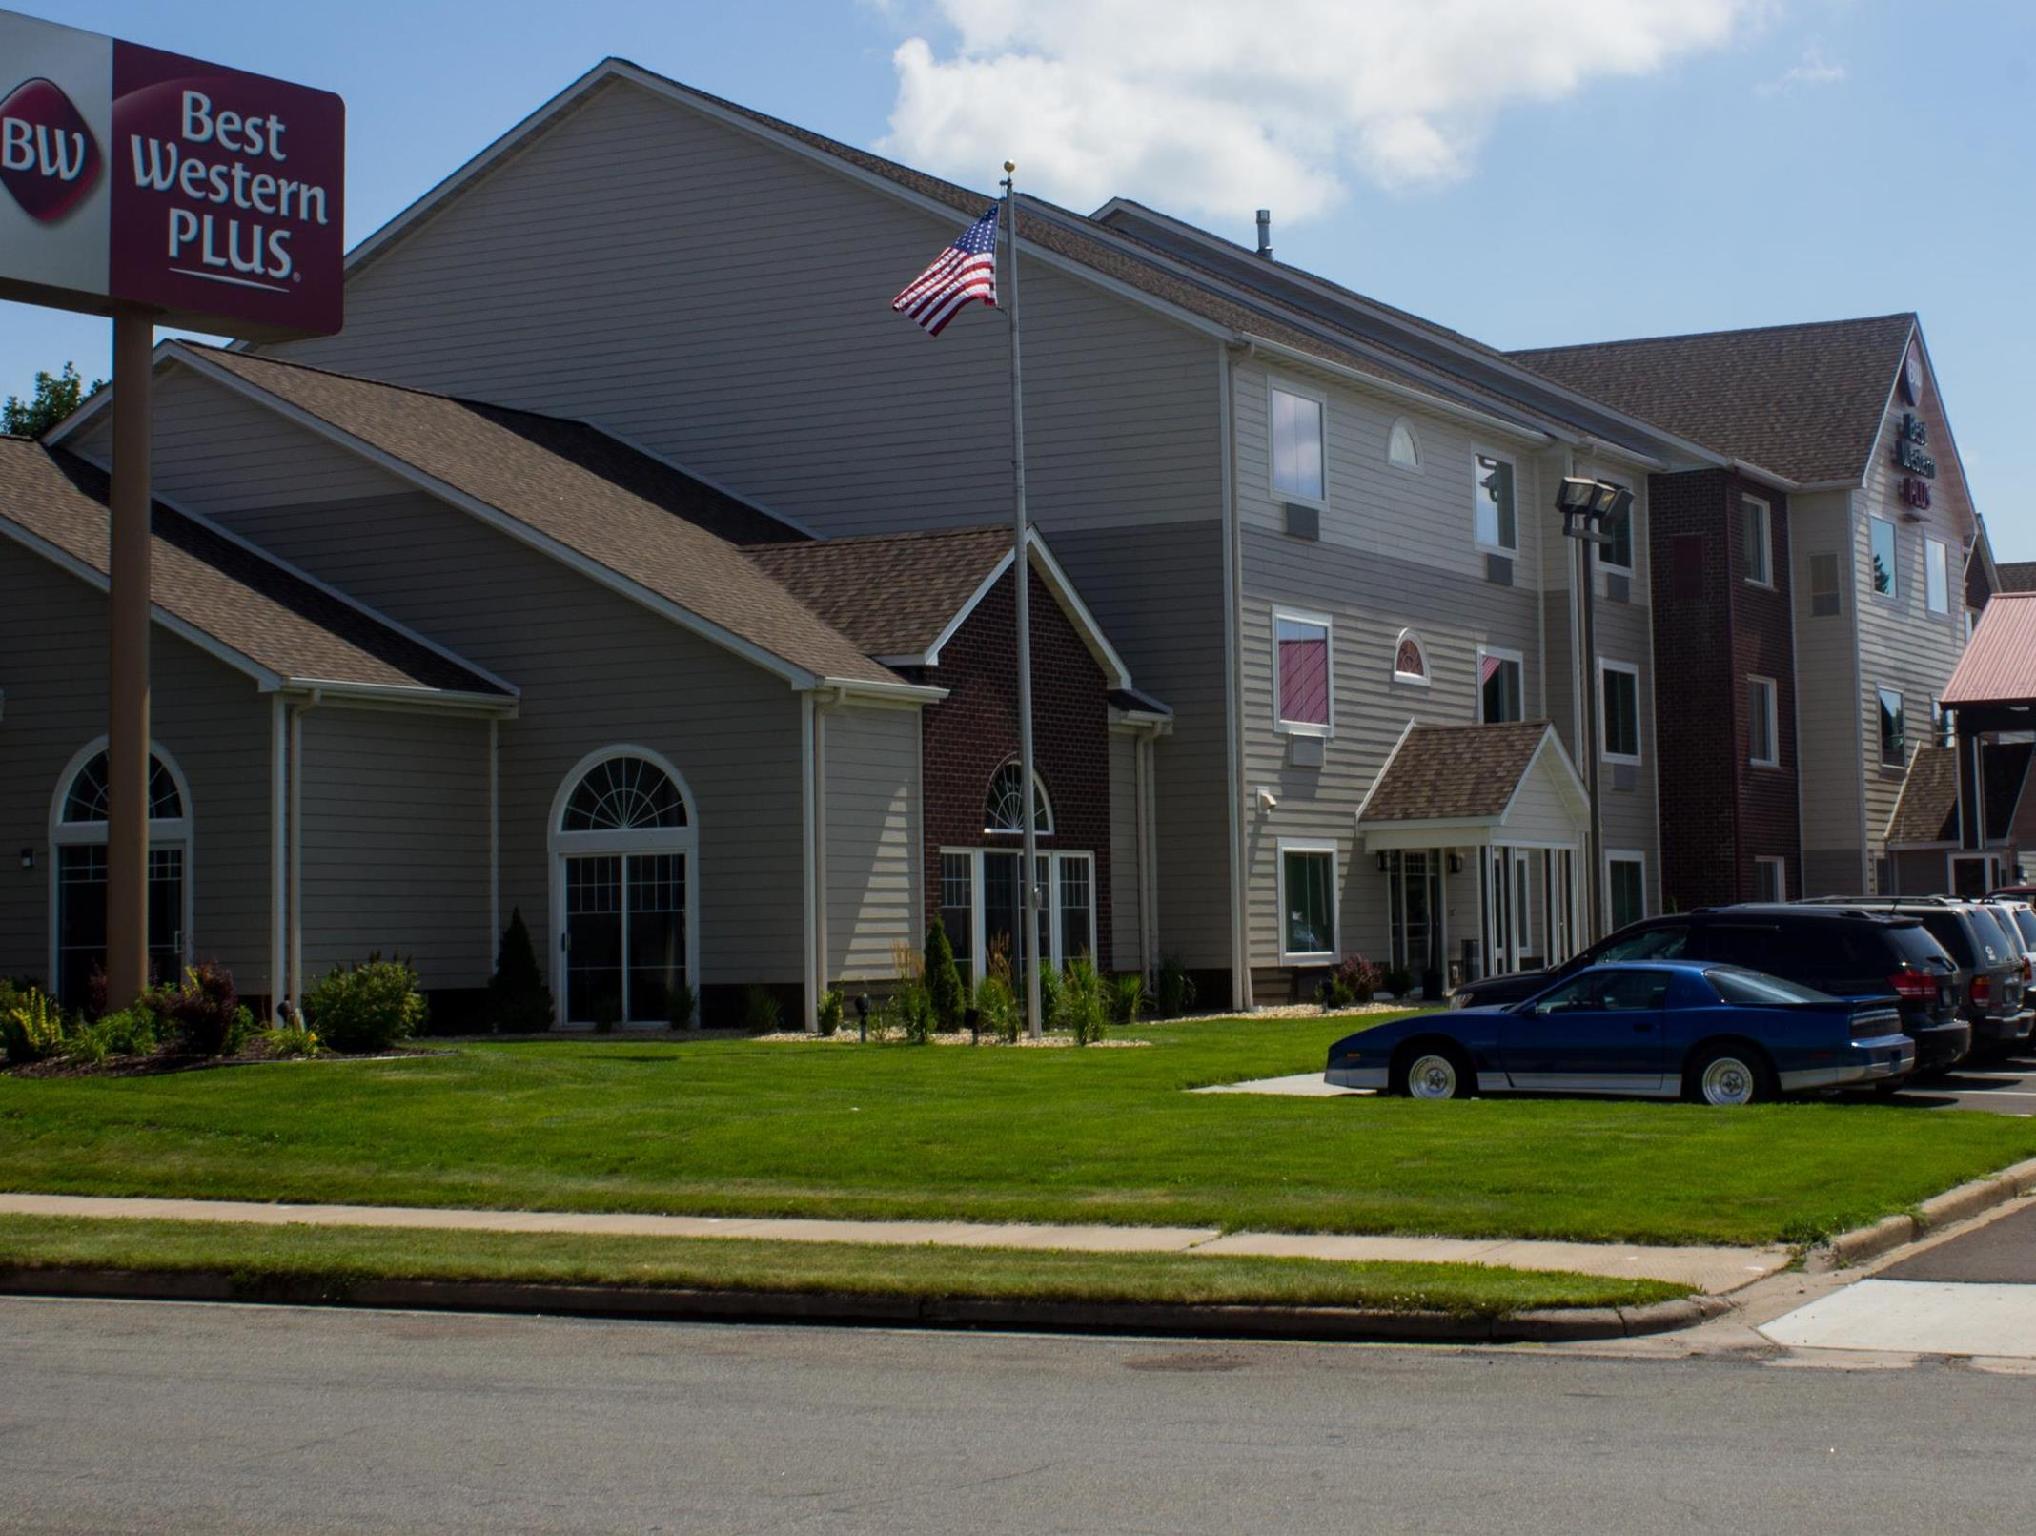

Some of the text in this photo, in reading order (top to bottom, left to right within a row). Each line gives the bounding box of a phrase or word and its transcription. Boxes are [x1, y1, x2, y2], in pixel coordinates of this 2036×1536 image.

[2, 117, 85, 181] BW
[182, 90, 287, 161] Best
[131, 134, 329, 225] Western
[169, 207, 292, 279] PLUS
